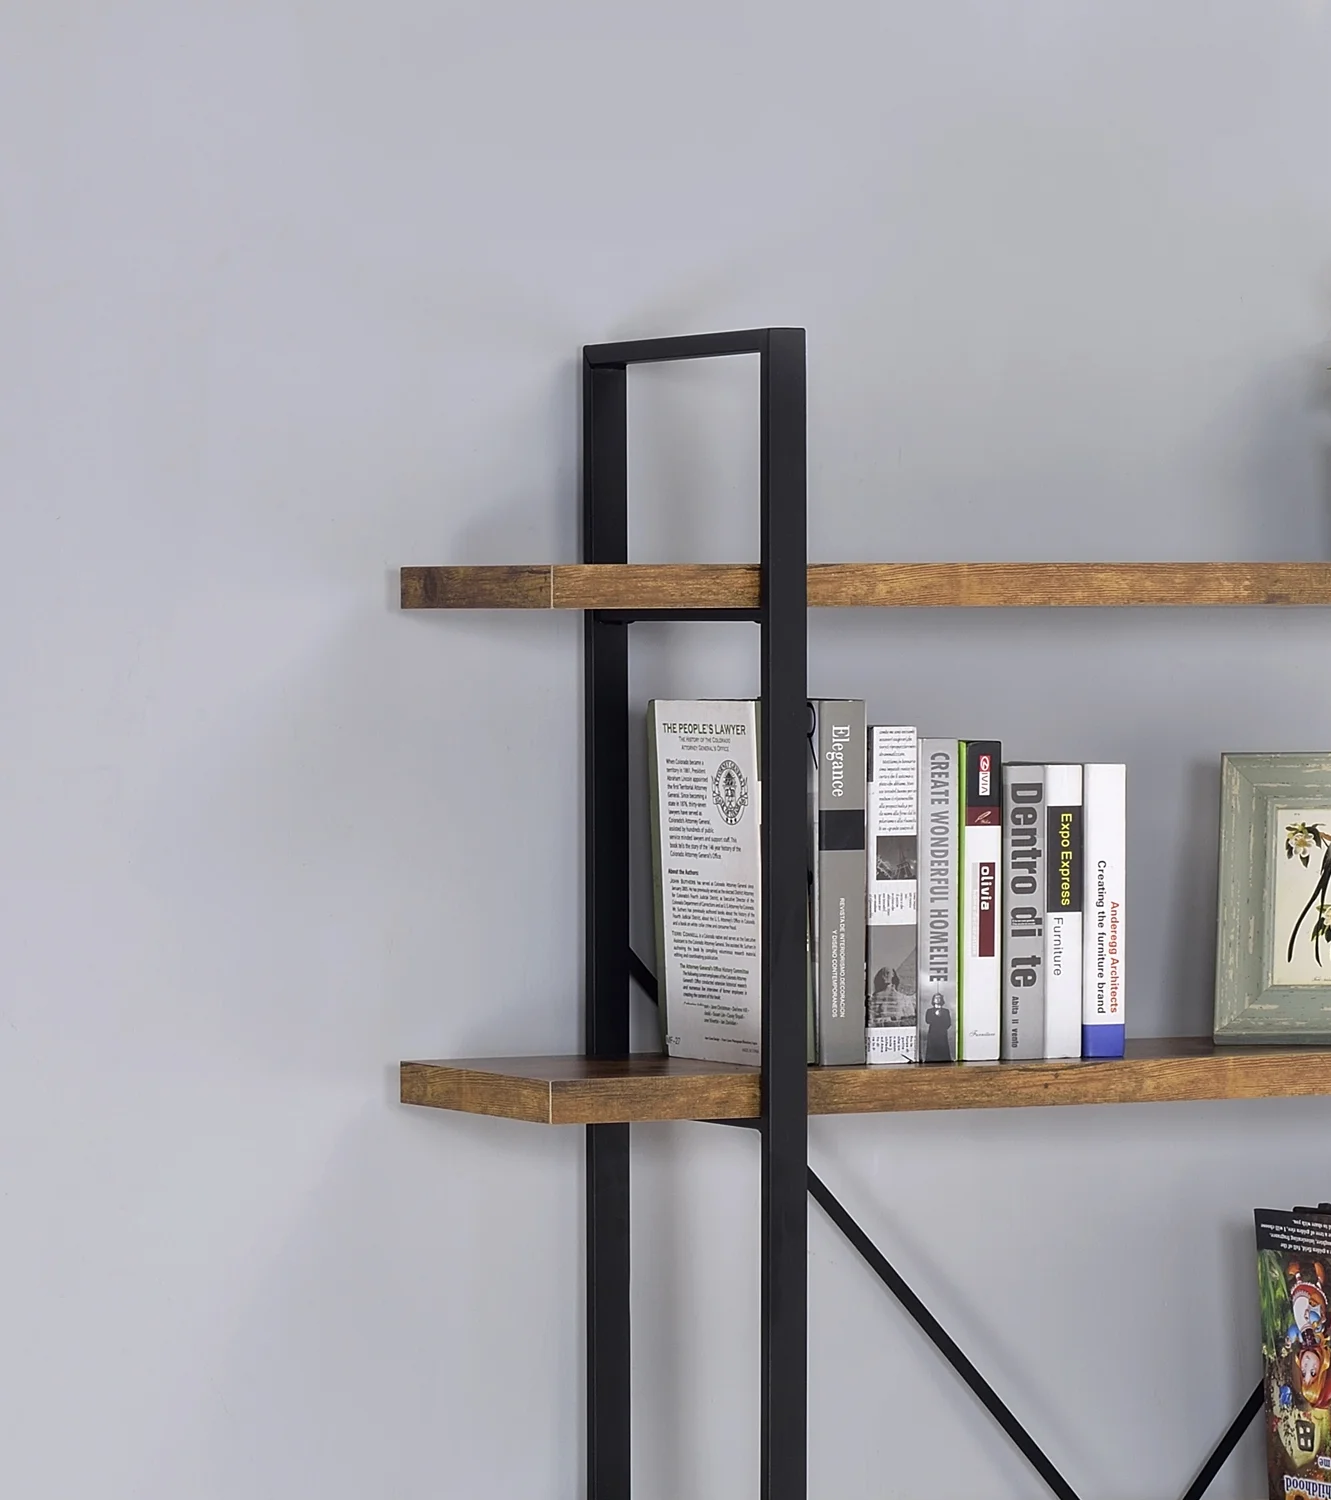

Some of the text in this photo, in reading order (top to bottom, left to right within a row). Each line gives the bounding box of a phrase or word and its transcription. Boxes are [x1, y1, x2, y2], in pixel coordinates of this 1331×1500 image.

[662, 723, 746, 735] THE PEOPLE'S LAWYER
[826, 725, 850, 797] Elegance
[929, 751, 950, 982] CREATE WONDERFUL HOMELIFE
[1011, 783, 1042, 894] Dentro
[1059, 814, 1072, 906] Expo Express
[981, 866, 994, 910] olivia
[1011, 906, 1042, 937] di
[1054, 918, 1063, 976] Furniture
[1096, 860, 1106, 1014] Creating the furniture brand
[1011, 955, 1041, 987] te
[1109, 902, 1119, 1013] Anderegg Architects
[1320, 1458, 1330, 1467] me
